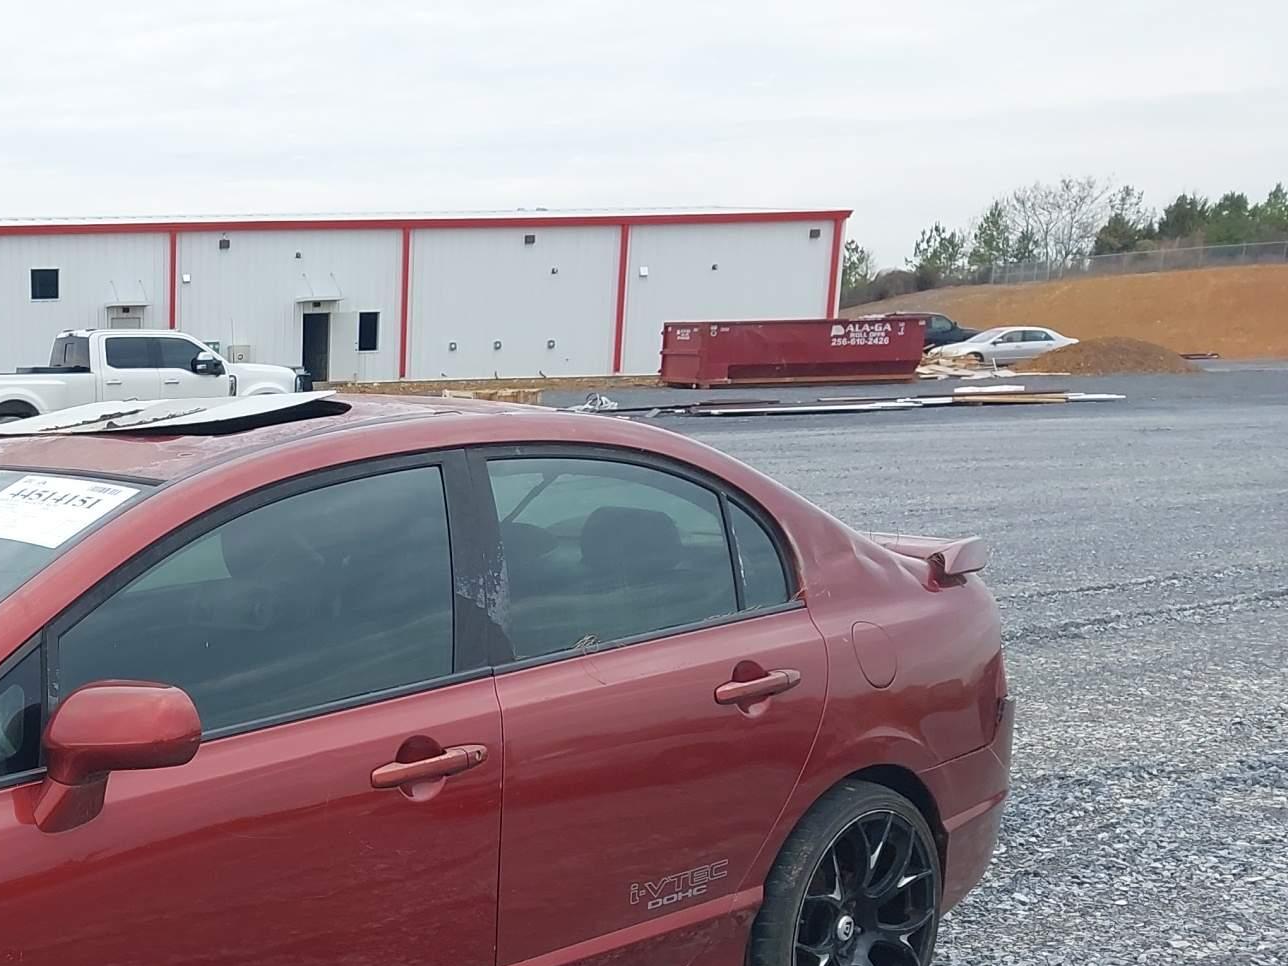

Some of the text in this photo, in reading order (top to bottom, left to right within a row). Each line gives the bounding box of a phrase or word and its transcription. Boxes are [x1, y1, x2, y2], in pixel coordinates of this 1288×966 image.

[10, 488, 103, 509] 44514151
[629, 859, 729, 905] i-VTEC
[647, 885, 707, 910] DOHC
